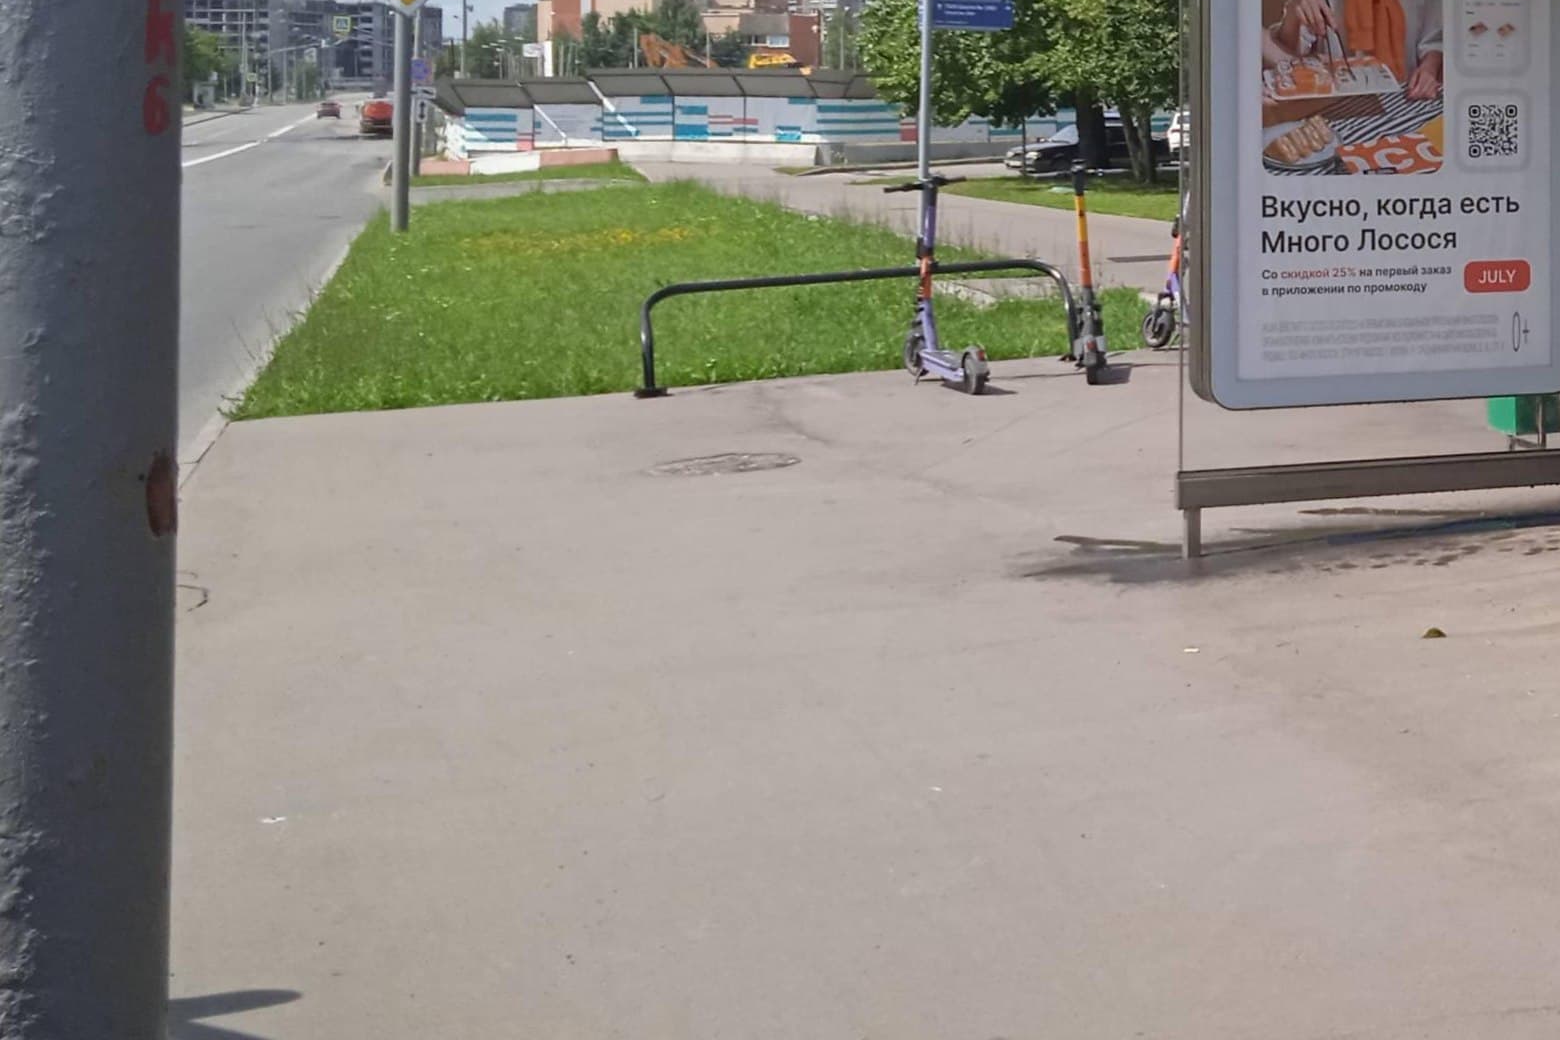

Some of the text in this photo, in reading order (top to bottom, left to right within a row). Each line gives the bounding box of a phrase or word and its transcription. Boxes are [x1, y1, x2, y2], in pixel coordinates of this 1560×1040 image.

[1261, 195, 1520, 223] Вкусно, когда есть
[1261, 228, 1458, 254] Много Лосося
[1261, 264, 1452, 280] Со скидкой 25% на первый заказ
[1478, 269, 1518, 285] JULY
[1261, 281, 1427, 298] в приложении по промокоду
